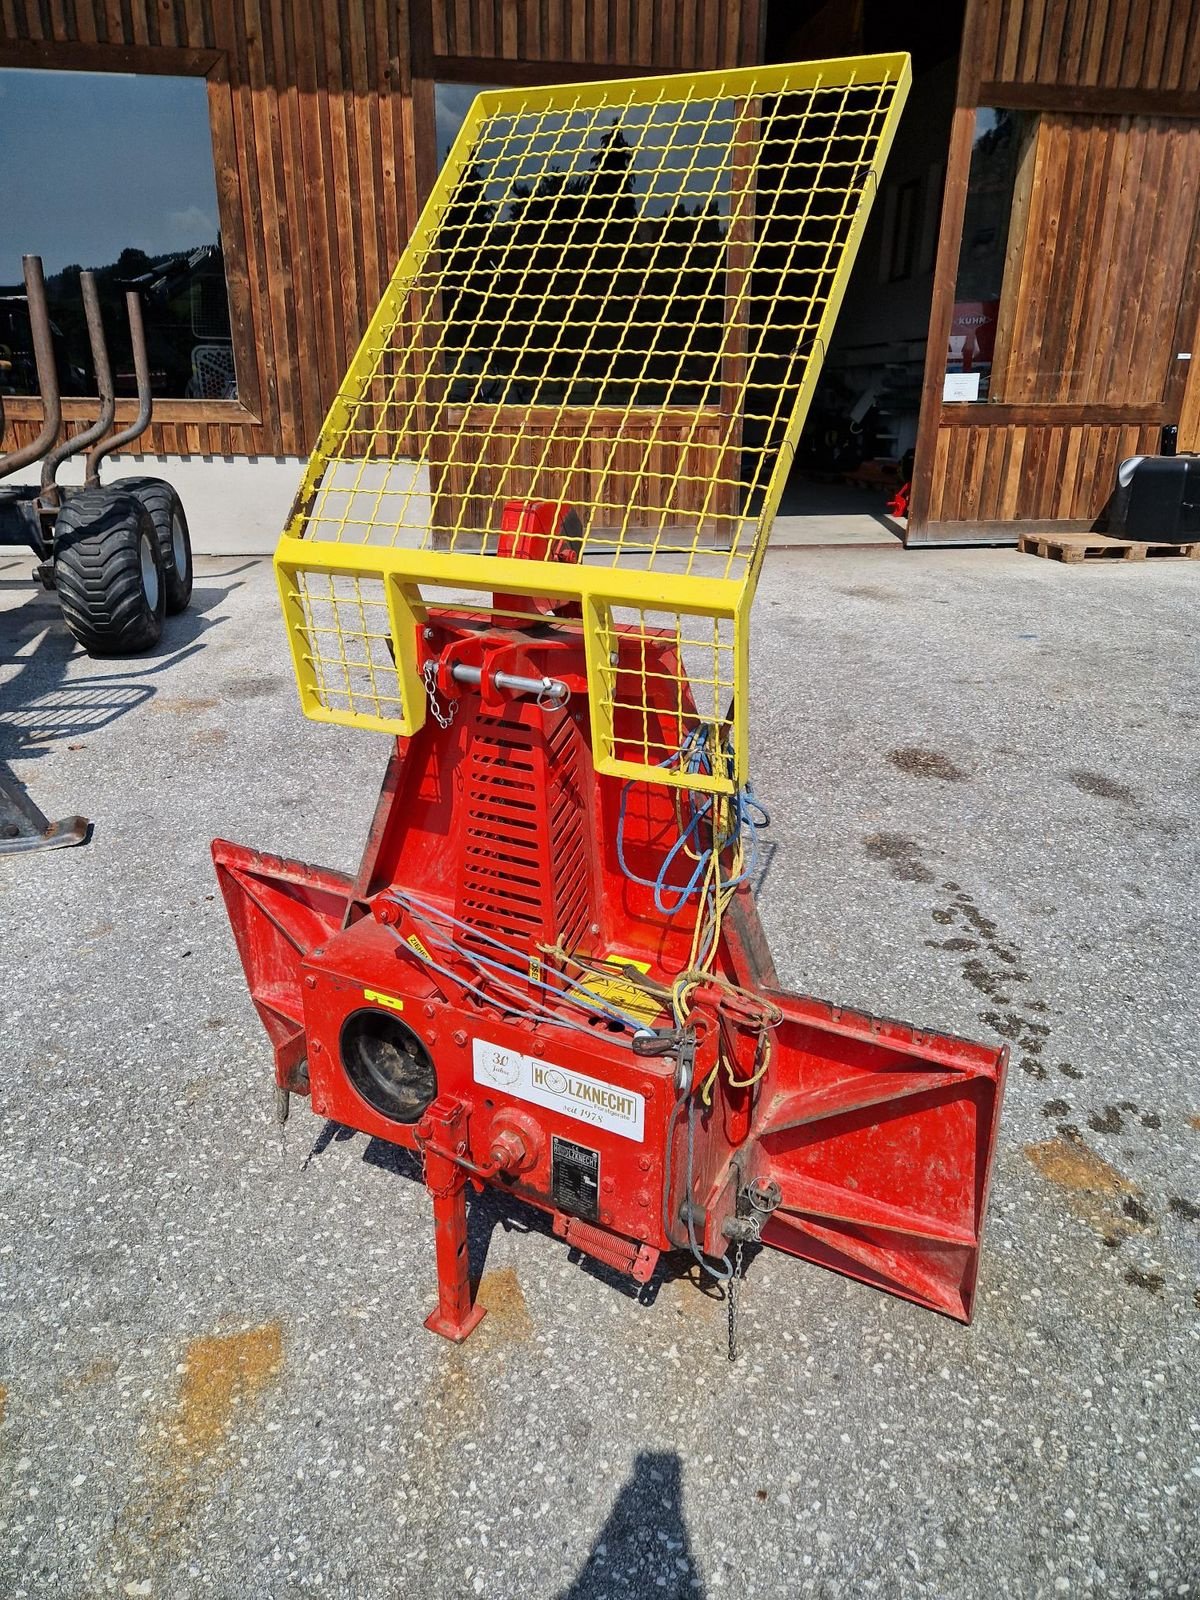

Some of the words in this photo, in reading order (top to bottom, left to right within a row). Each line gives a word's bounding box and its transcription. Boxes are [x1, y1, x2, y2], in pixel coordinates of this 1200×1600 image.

[958, 315, 987, 325] KUHN
[492, 1052, 509, 1067] 30
[534, 1067, 634, 1116] HOLZKNECHT
[562, 1105, 578, 1117] seit
[580, 1108, 604, 1123] 1978
